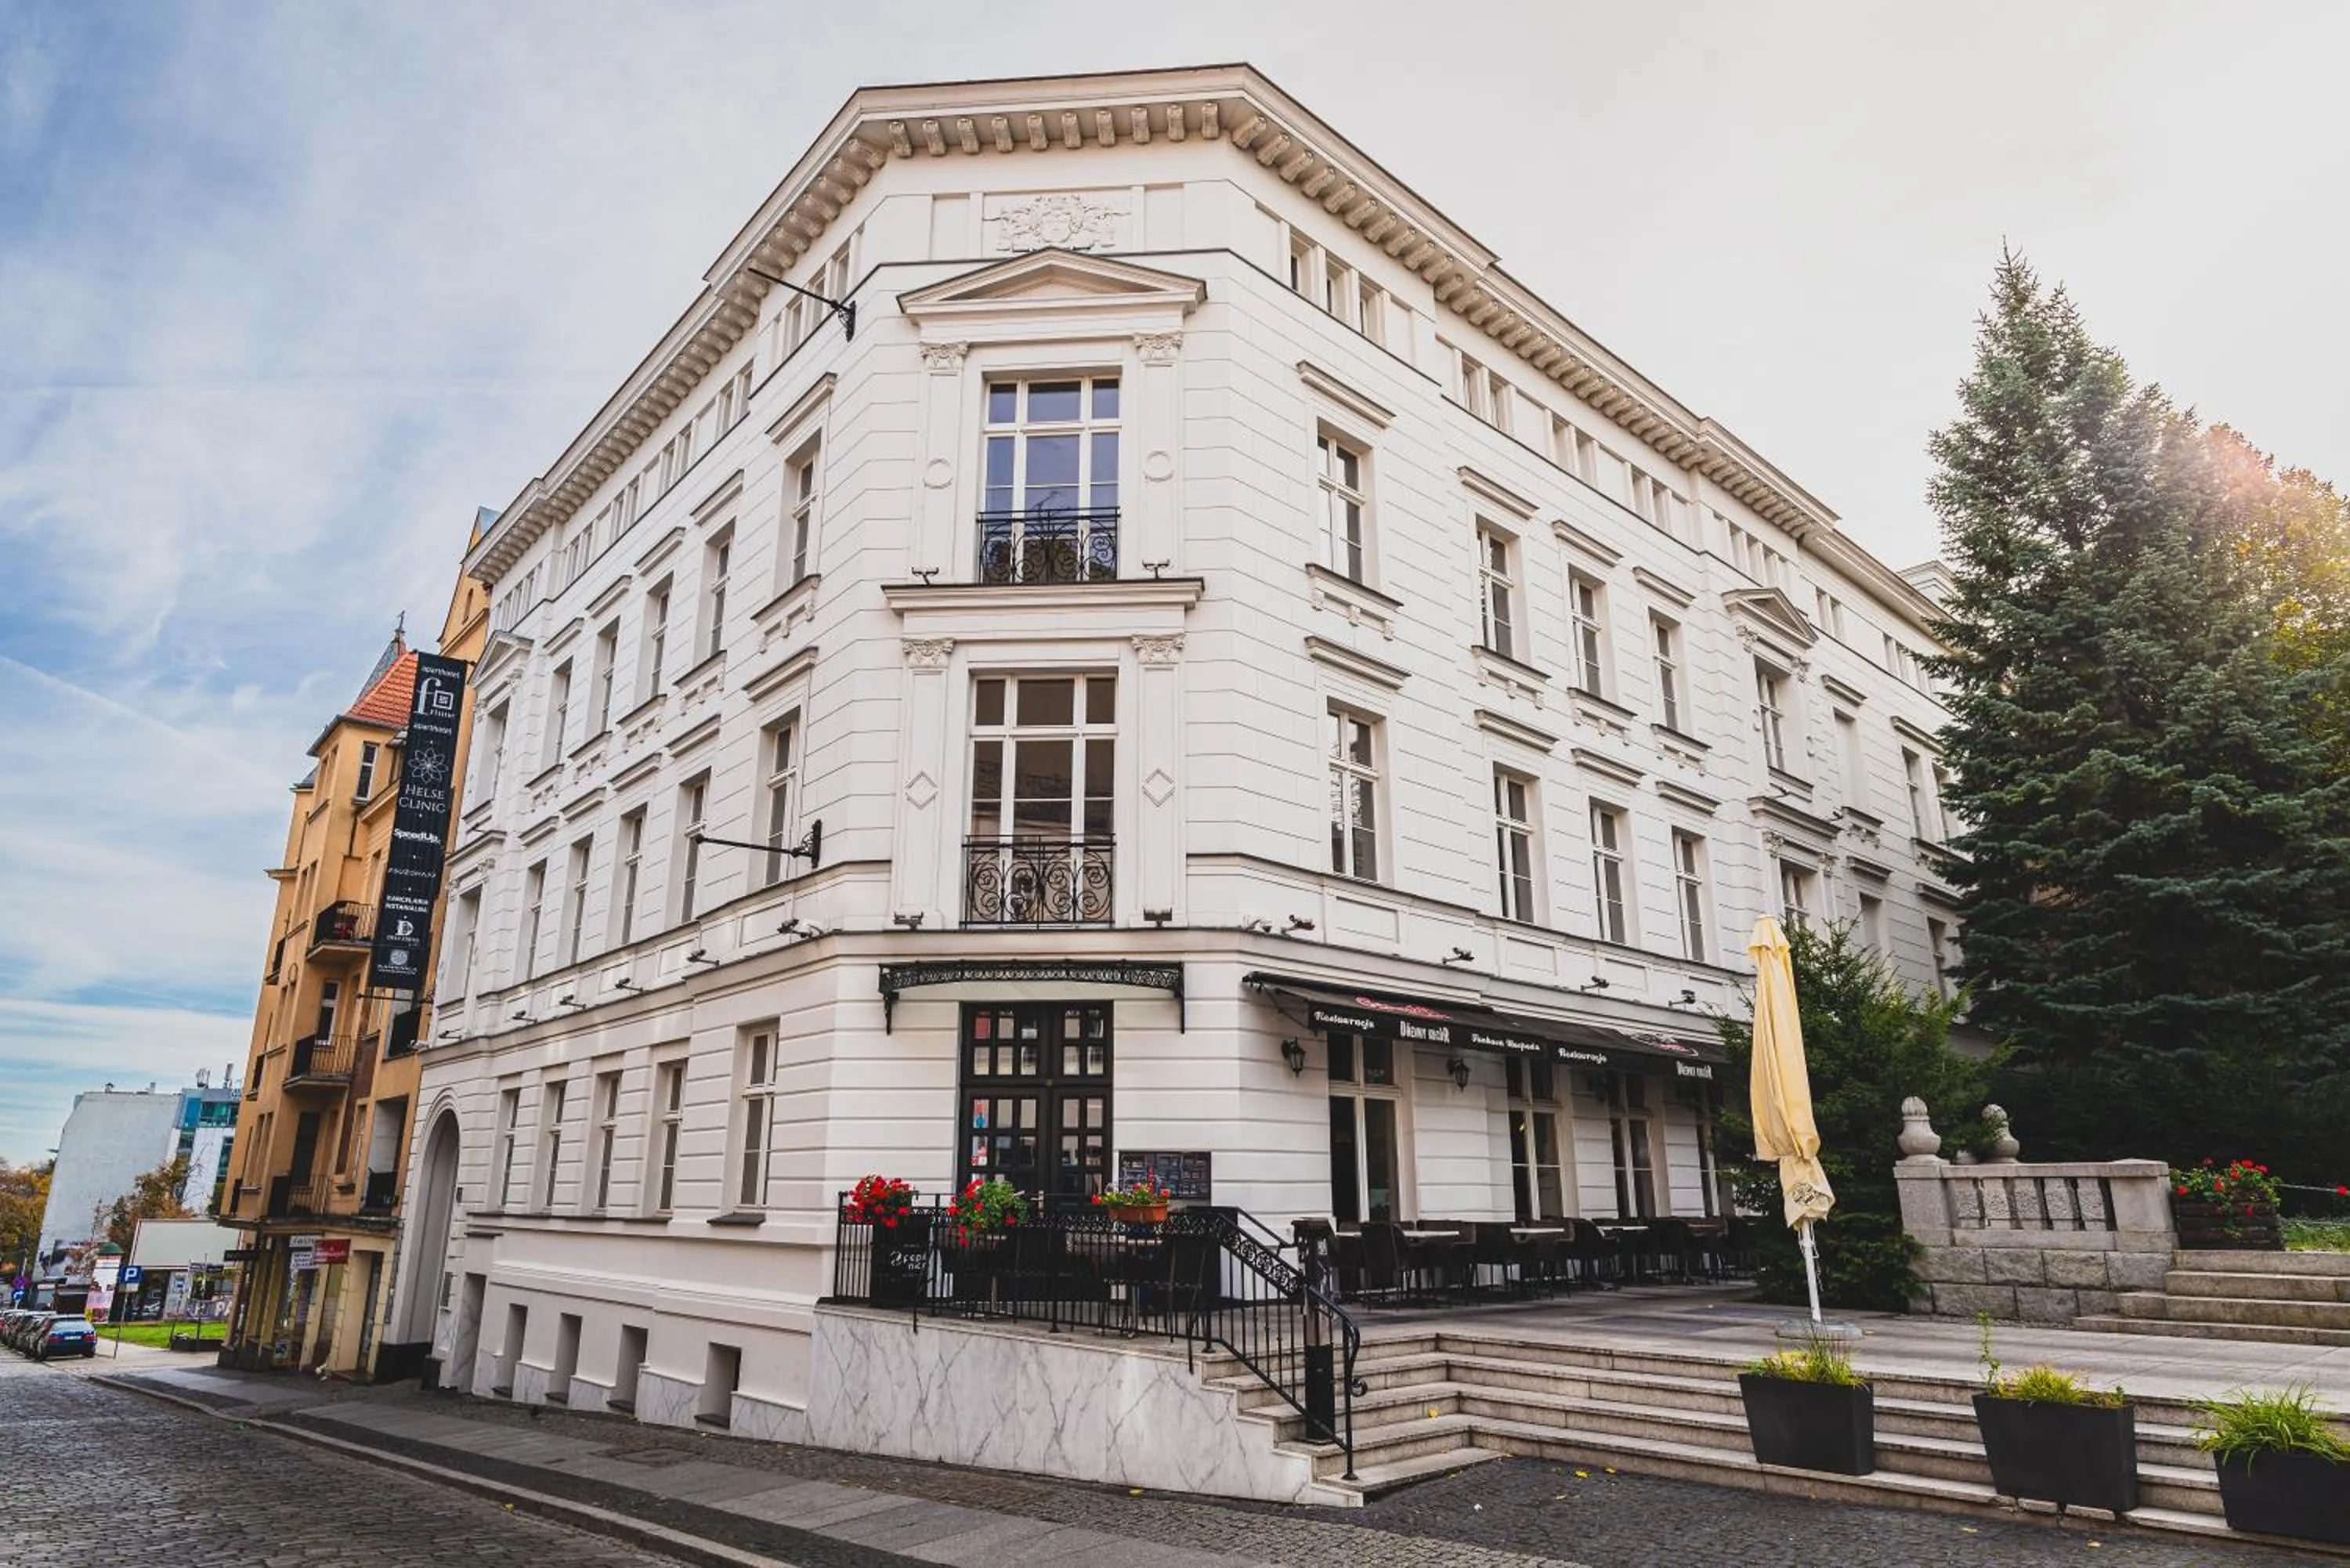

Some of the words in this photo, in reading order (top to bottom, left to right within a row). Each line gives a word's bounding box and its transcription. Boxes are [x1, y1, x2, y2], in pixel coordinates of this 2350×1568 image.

[405, 784, 446, 800] HELSE
[399, 797, 446, 814] CLINIC
[125, 1268, 137, 1282] P
